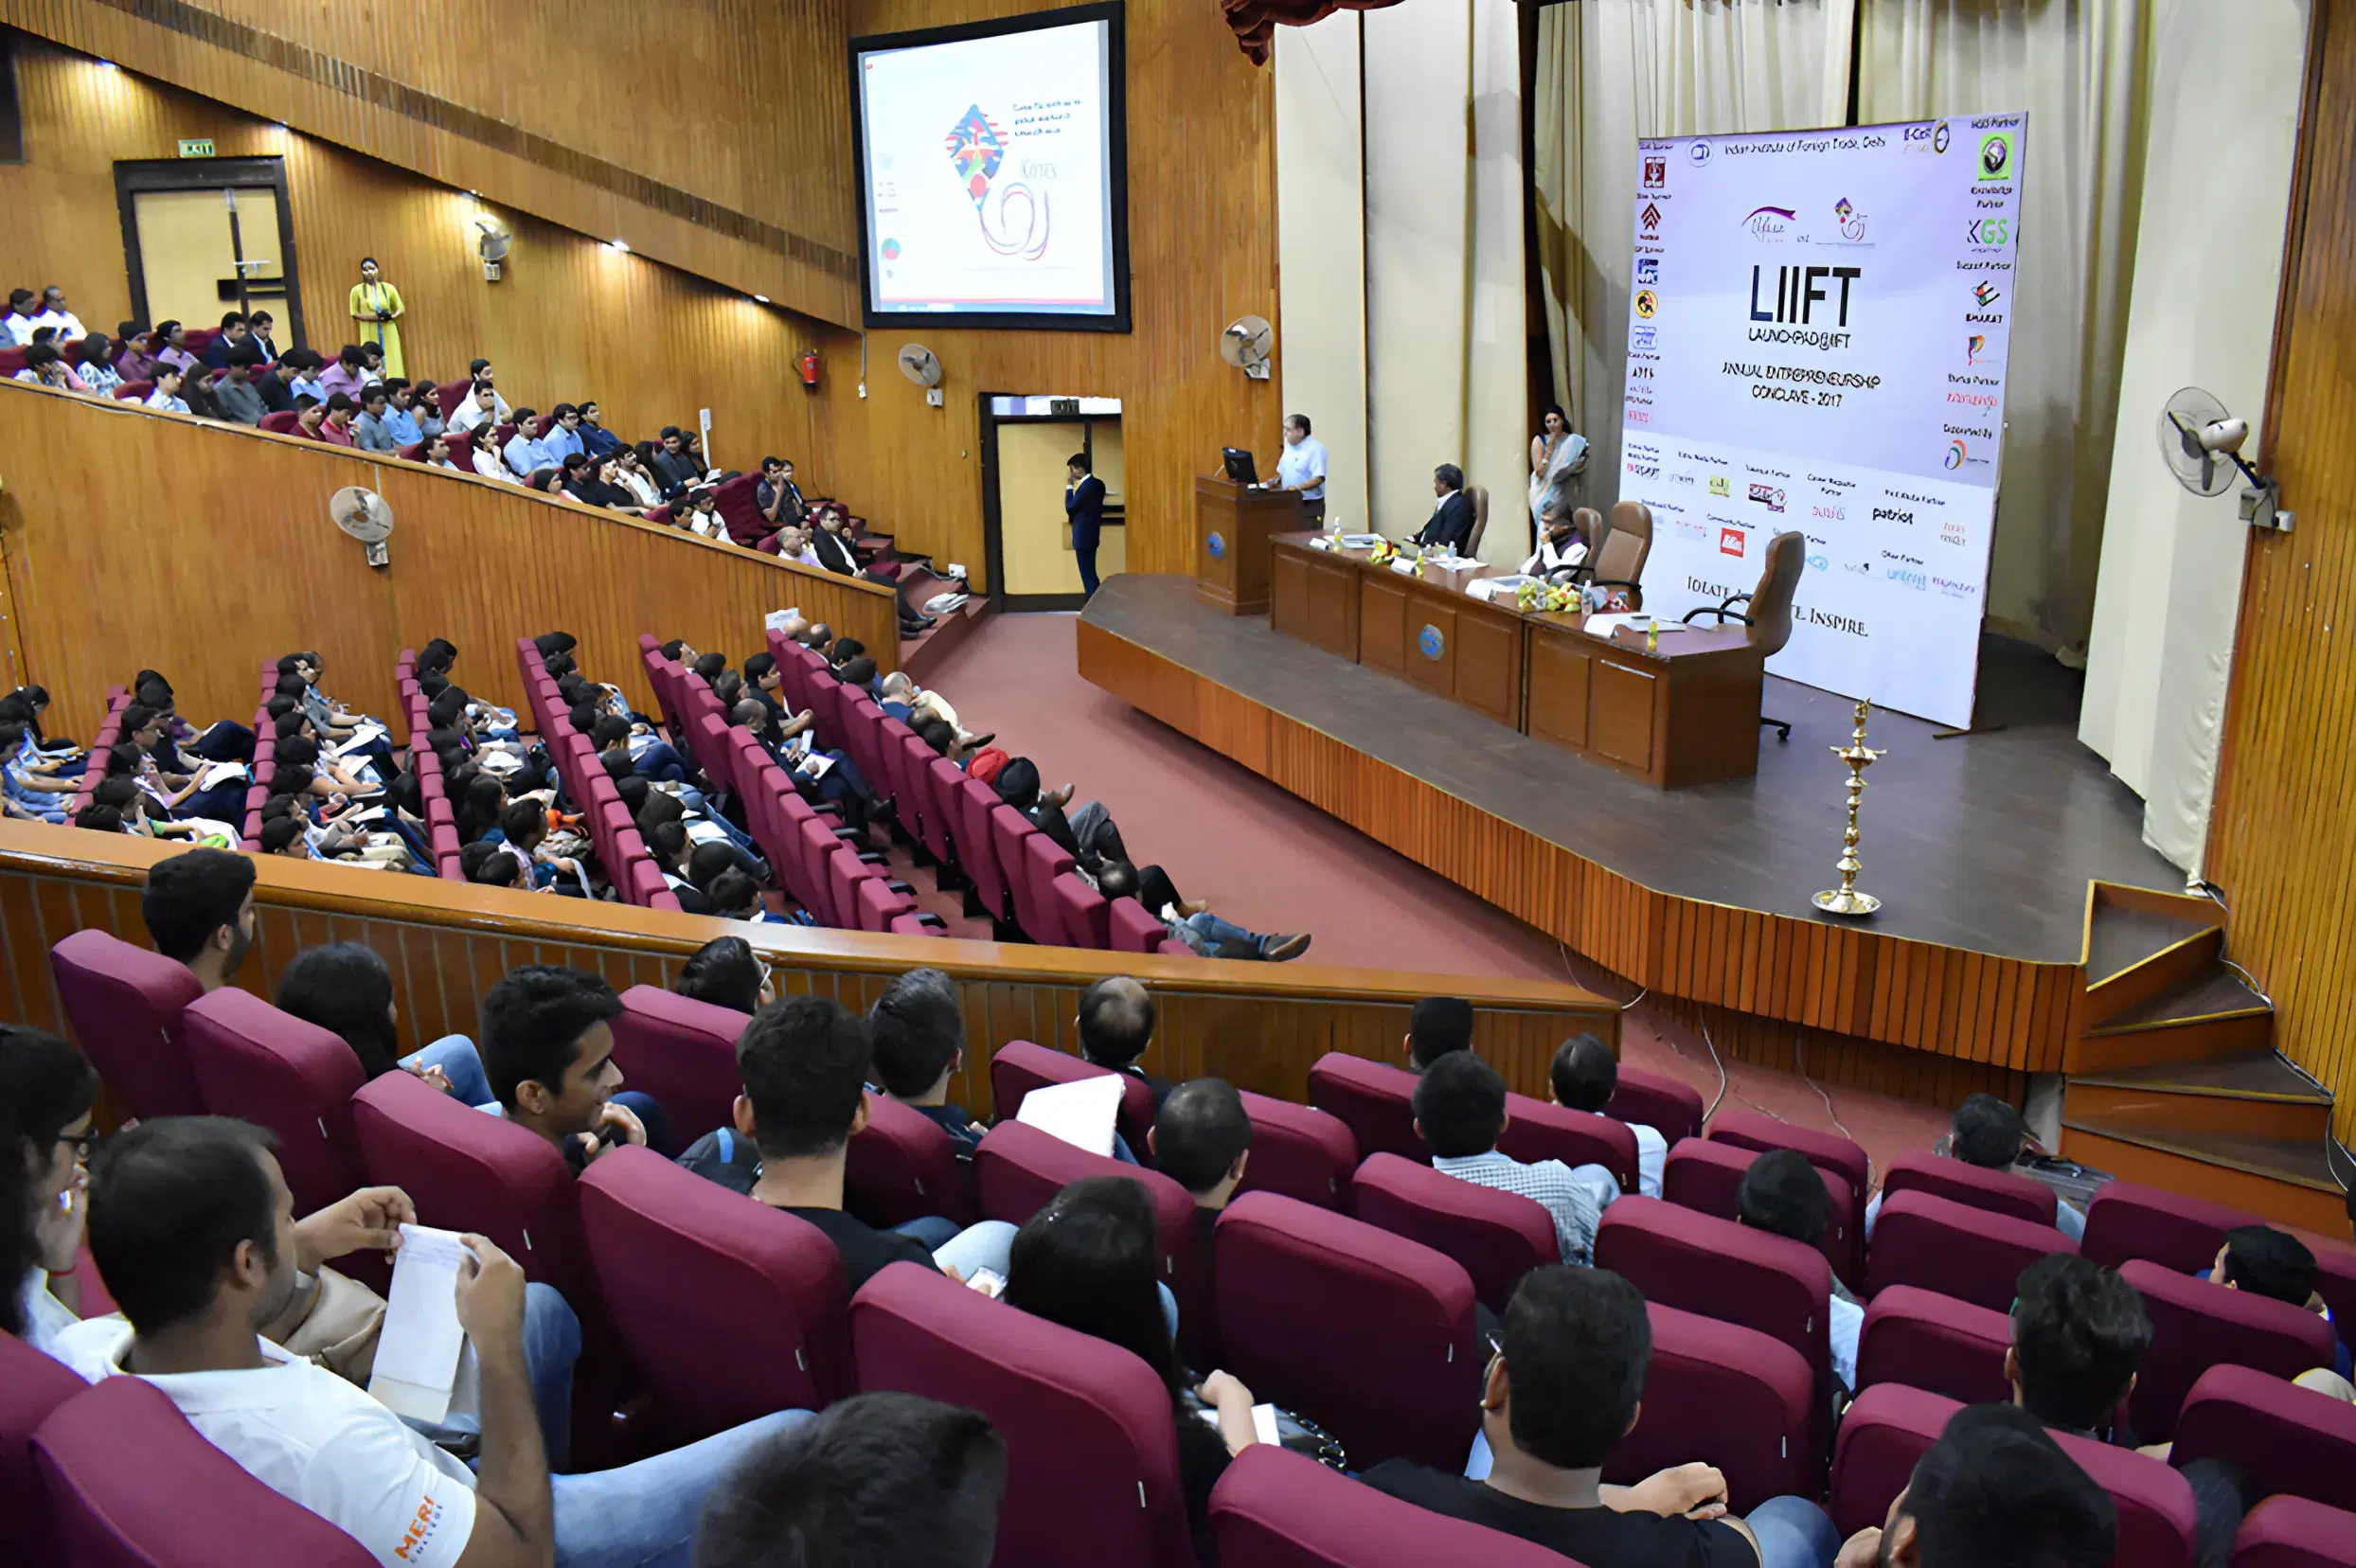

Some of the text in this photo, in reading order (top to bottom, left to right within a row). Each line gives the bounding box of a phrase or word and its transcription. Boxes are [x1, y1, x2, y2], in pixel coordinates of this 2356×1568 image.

[1967, 219, 2008, 245] KGS
[1750, 265, 1862, 328] LIIFT
[1817, 392, 1843, 407] 2017
[394, 1494, 435, 1560] MERI
